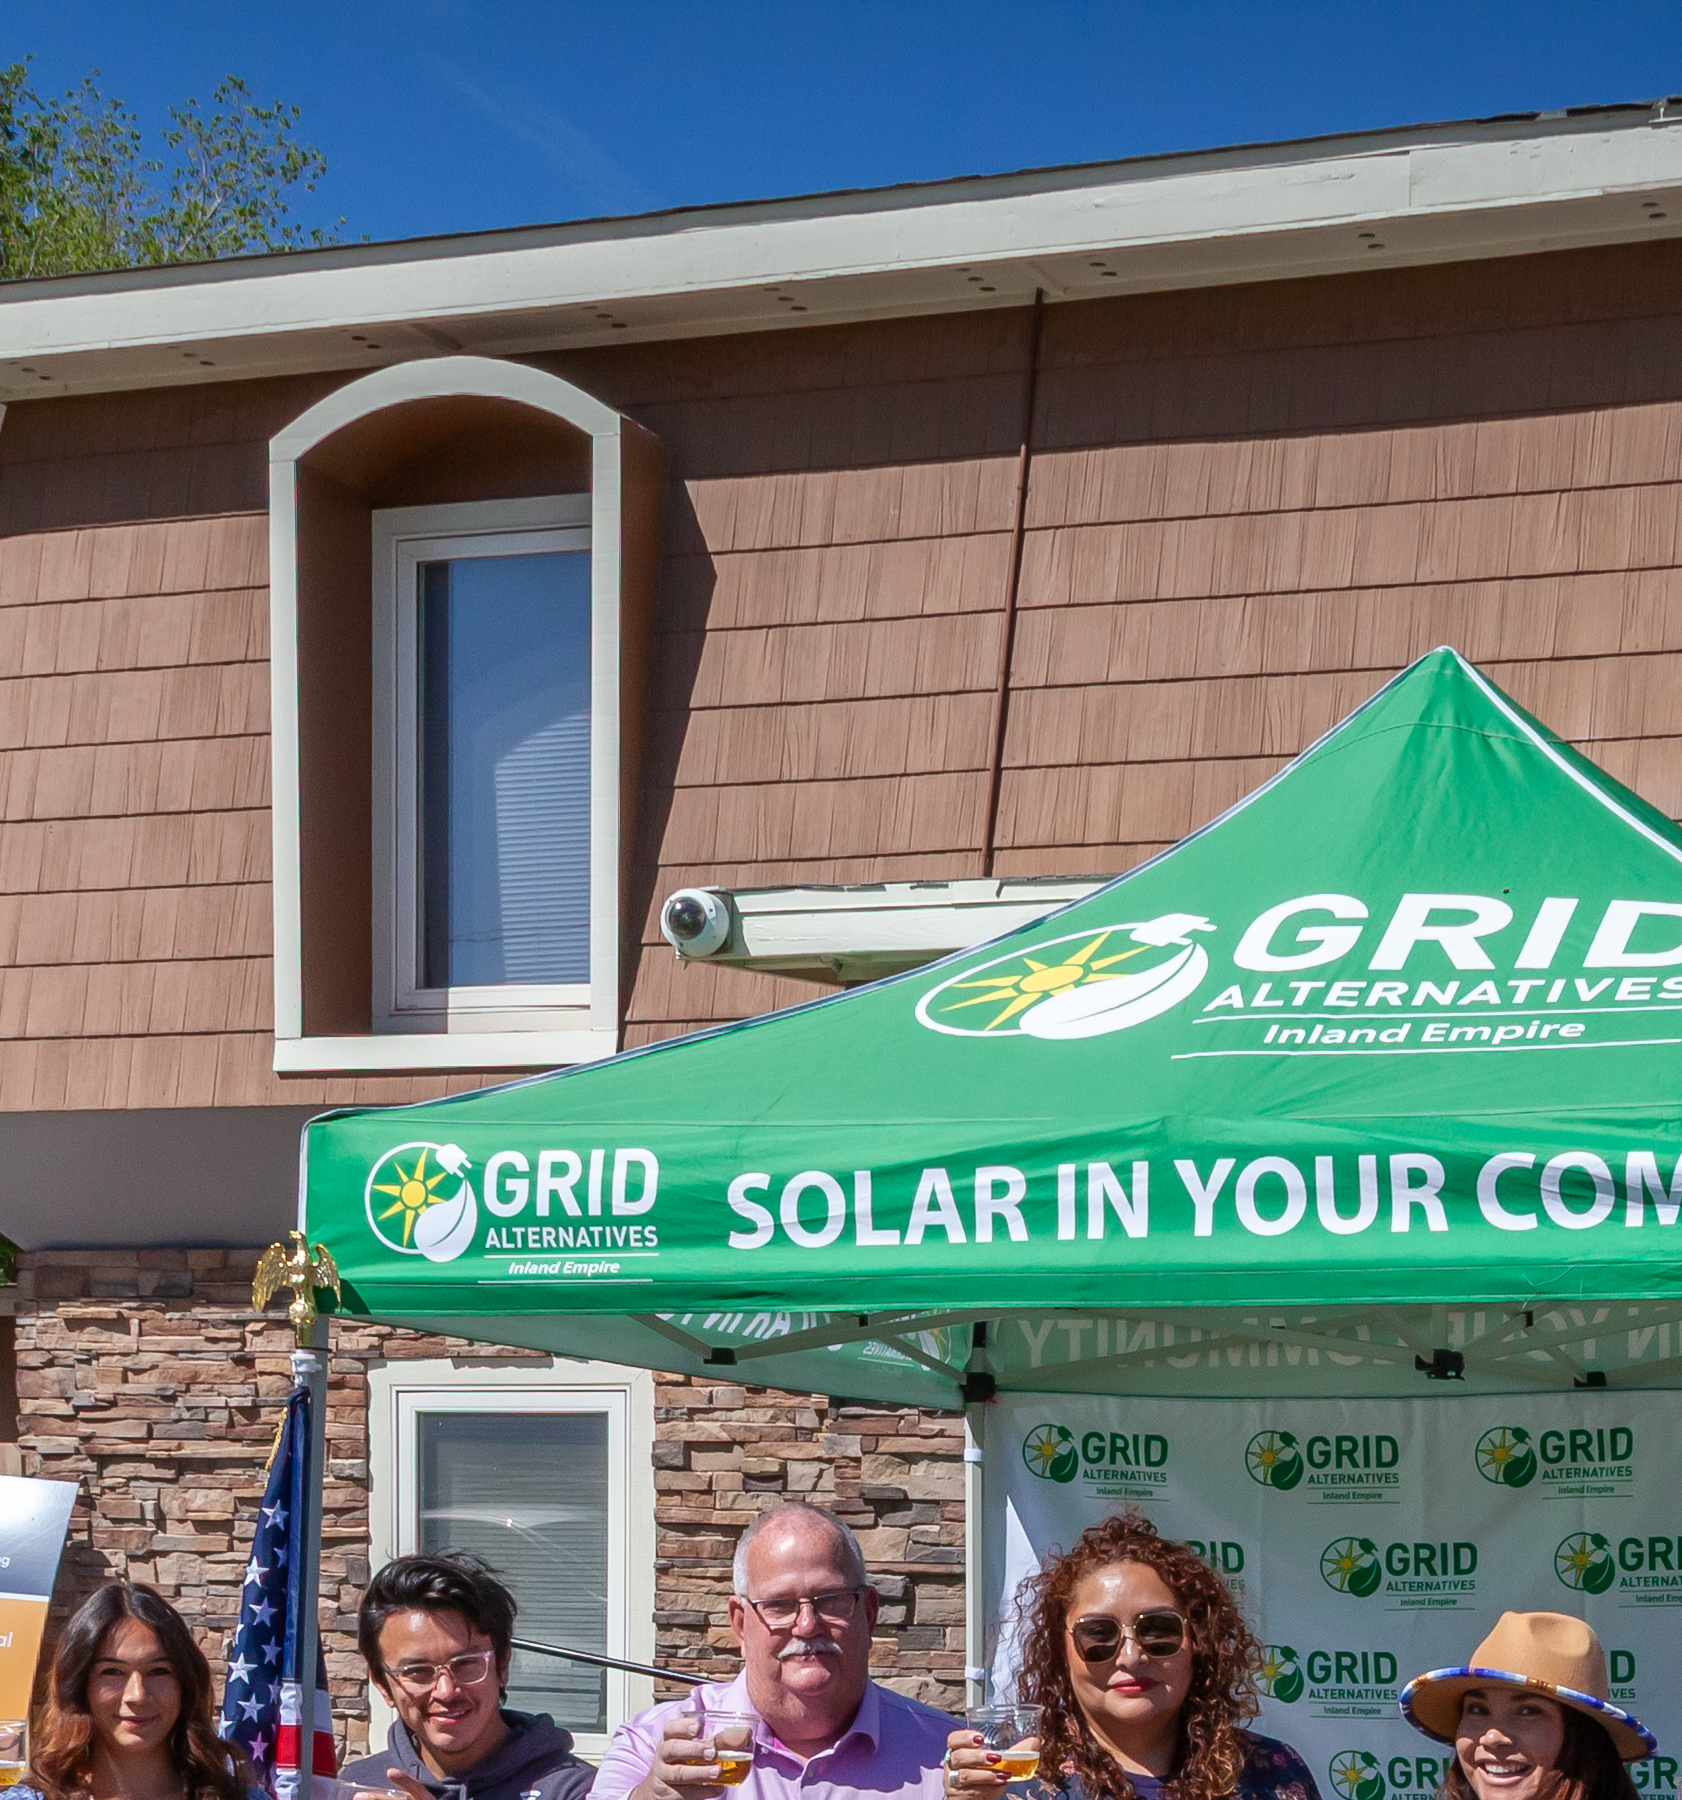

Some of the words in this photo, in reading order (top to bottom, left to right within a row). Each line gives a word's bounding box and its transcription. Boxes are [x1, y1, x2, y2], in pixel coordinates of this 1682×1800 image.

[1262, 1023, 1411, 1046] Inland
[1420, 1020, 1587, 1046] Empire
[485, 1148, 659, 1218] GRID
[727, 1165, 1029, 1250] SOLAR
[1056, 1161, 1149, 1242] IN
[1173, 1153, 1448, 1239] YOUR
[485, 1225, 658, 1249] ALTERNATIVES
[508, 1260, 561, 1275] Inland
[563, 1260, 620, 1276] Empire
[1081, 1431, 1168, 1467] GRID
[1306, 1434, 1399, 1469] GRID
[1539, 1427, 1633, 1464] GRID
[1082, 1469, 1167, 1483] ALTERNATIVES
[1307, 1472, 1399, 1484] ALTERNATIVES
[1542, 1466, 1632, 1479] ALTERNATIVES
[1322, 1491, 1350, 1499] Inland
[1352, 1491, 1382, 1501] Empire
[1558, 1485, 1584, 1494] Inland
[1586, 1484, 1614, 1494] Empire
[1385, 1542, 1478, 1576] GRID
[1386, 1580, 1476, 1591] ALTERNATIVES
[1635, 1592, 1663, 1602] Inland
[1307, 1651, 1397, 1684] GRID
[1308, 1688, 1398, 1700] ALTERNATIVES
[1323, 1706, 1350, 1714] Inland
[1351, 1706, 1381, 1715] Empire
[1388, 1756, 1450, 1789] GRI
